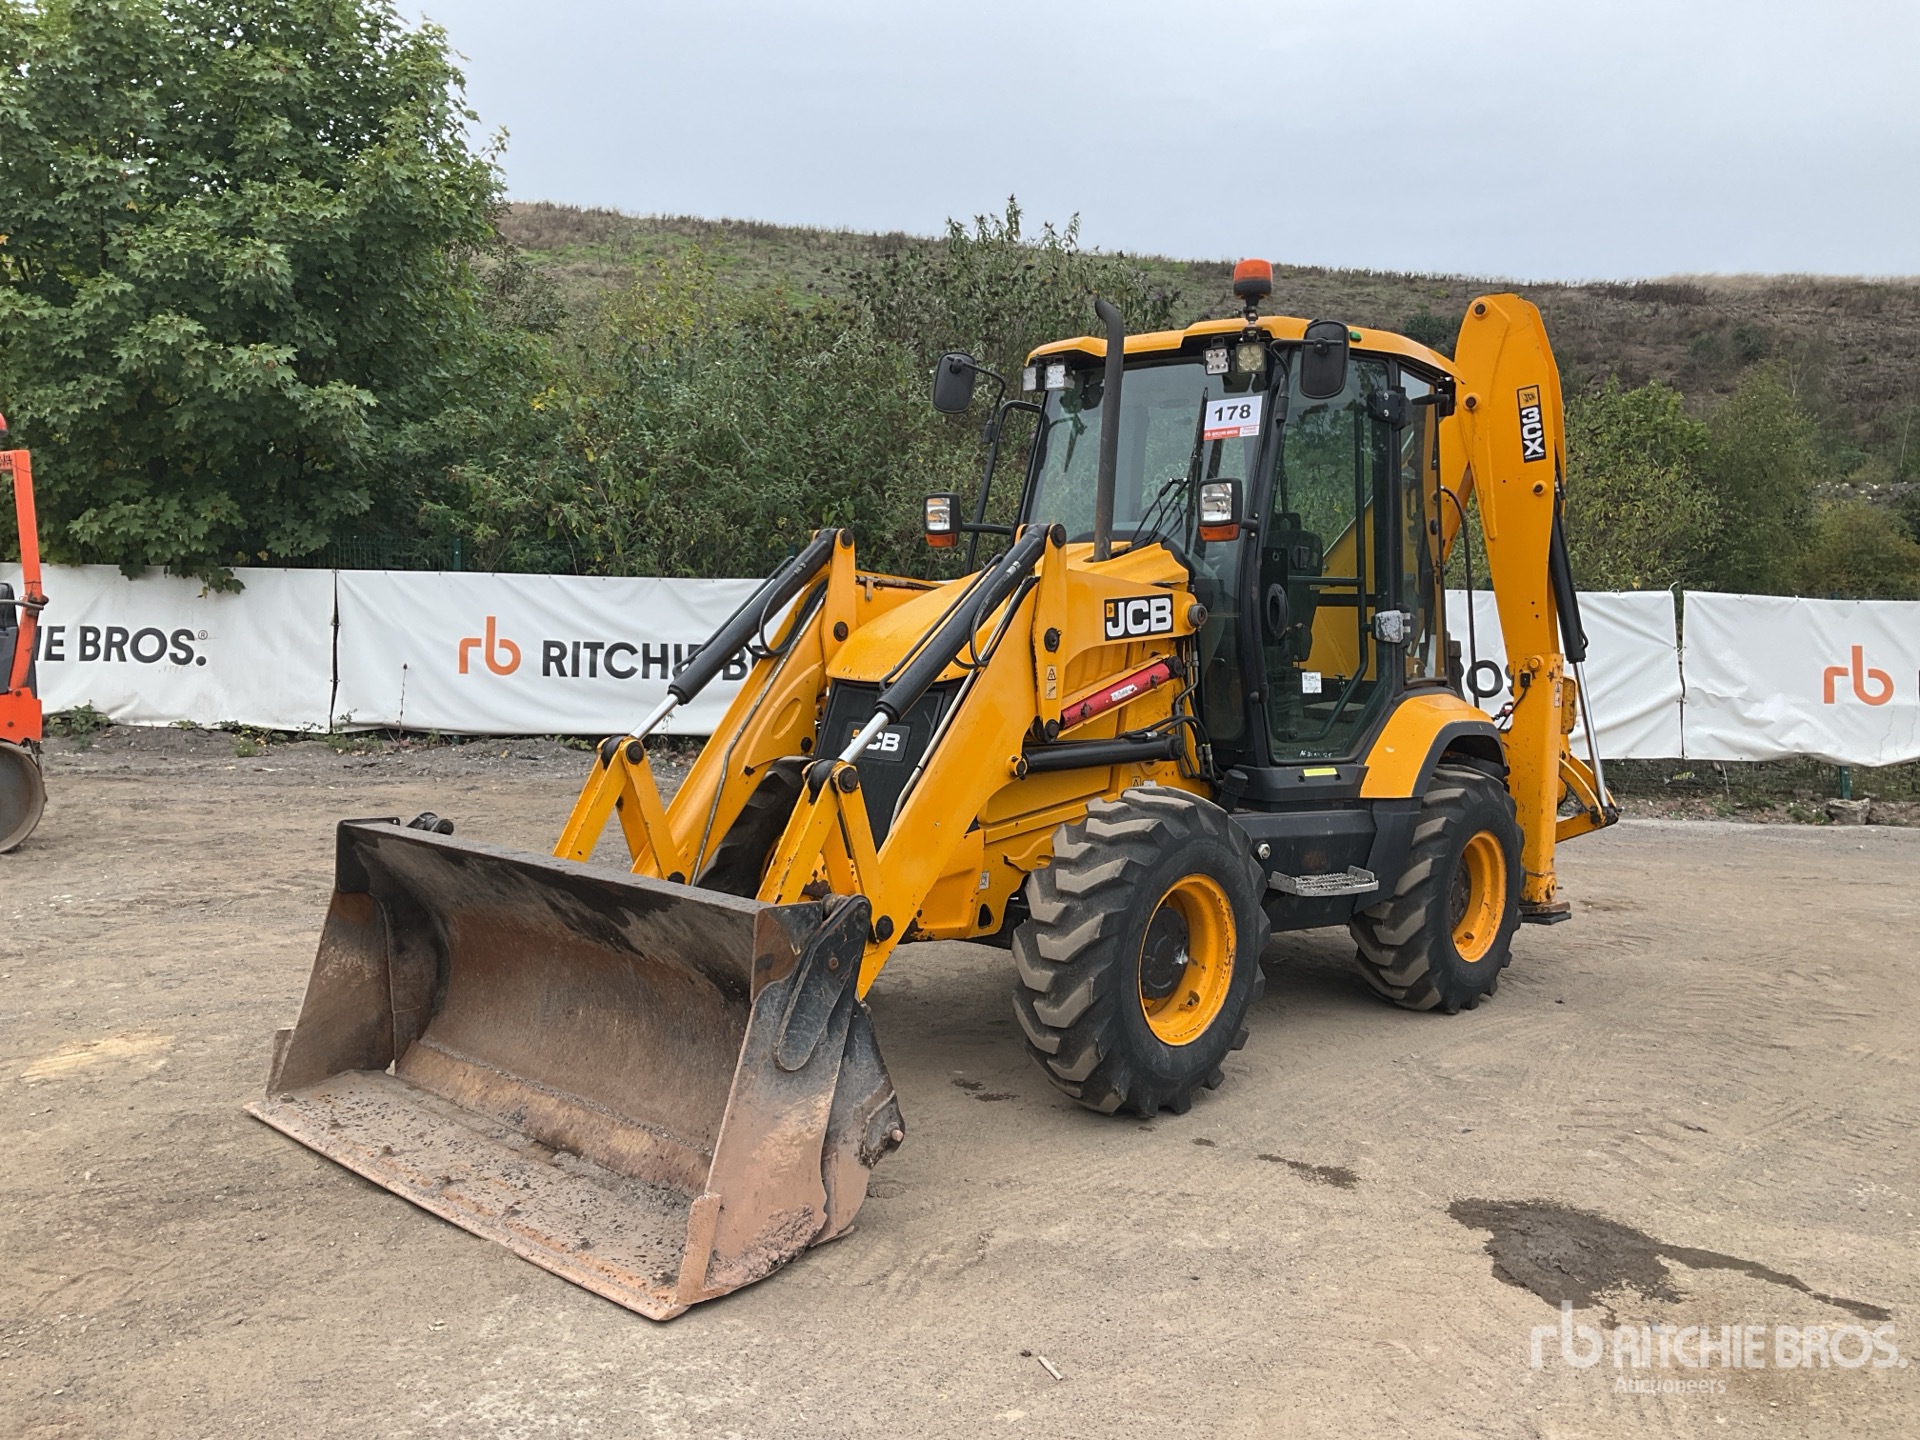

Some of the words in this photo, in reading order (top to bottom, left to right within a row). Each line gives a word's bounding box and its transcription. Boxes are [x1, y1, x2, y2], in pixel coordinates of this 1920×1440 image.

[1214, 404, 1252, 422] 178
[1521, 407, 1545, 456] 3CX
[1106, 597, 1173, 638] JCB
